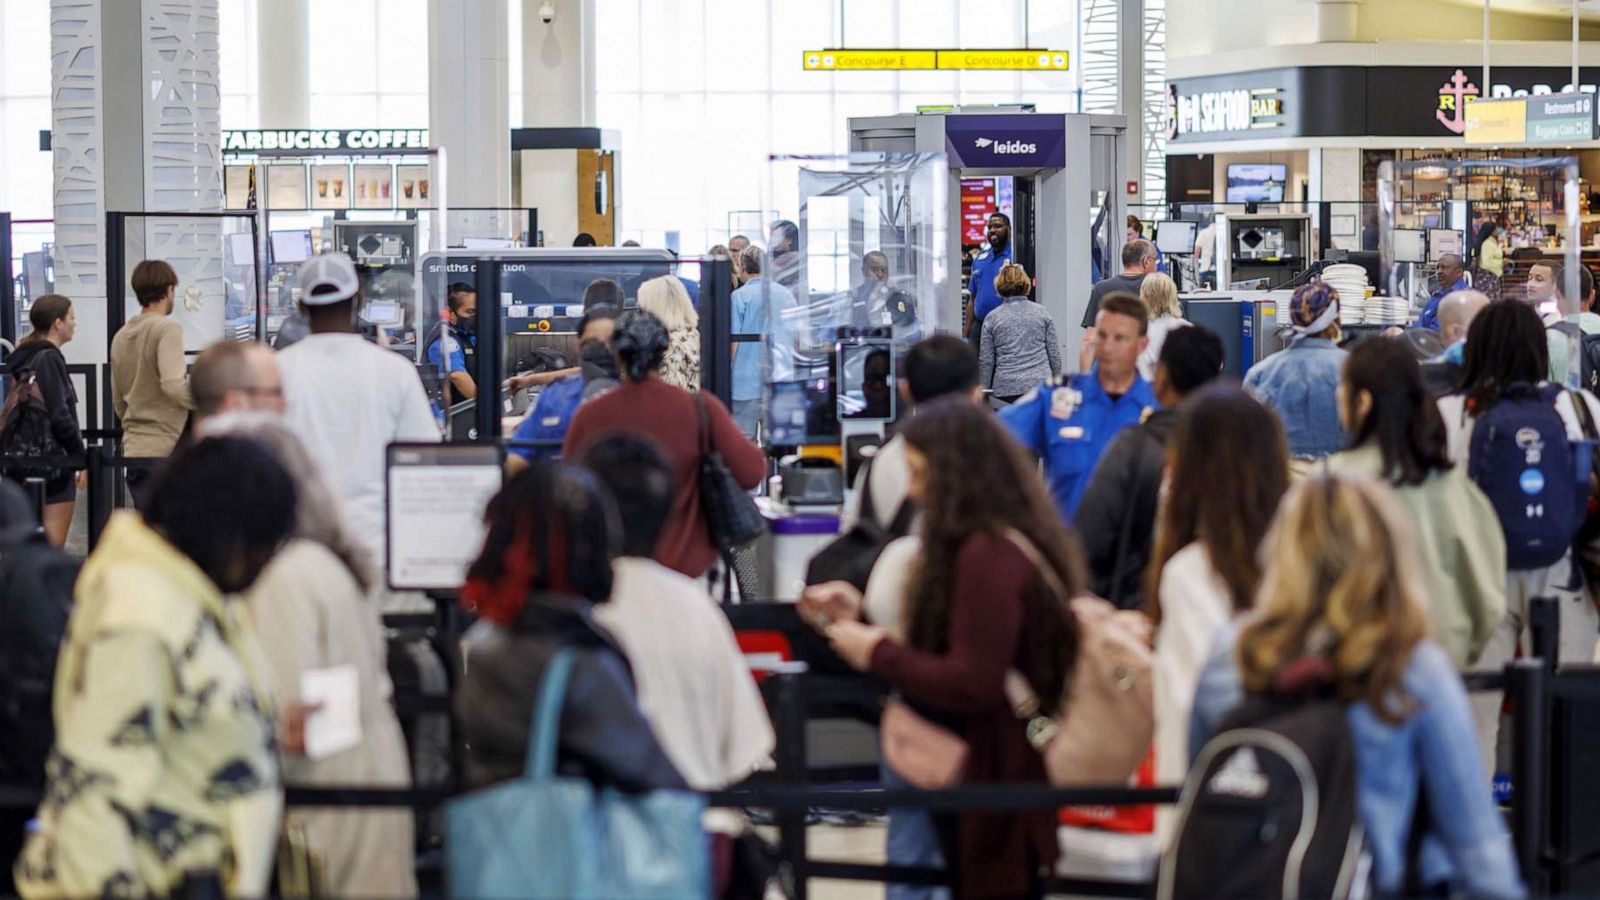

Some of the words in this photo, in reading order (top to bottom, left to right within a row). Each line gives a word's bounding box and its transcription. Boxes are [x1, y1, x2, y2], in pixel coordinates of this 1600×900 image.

[836, 56, 896, 66] Concourse
[899, 56, 906, 66] E
[964, 56, 1023, 66] Concourse
[1026, 56, 1036, 66] D
[1201, 89, 1250, 132] SEAFOOD
[1251, 98, 1279, 117] BAR
[1544, 101, 1576, 115] Restrooms
[221, 130, 341, 150] TARBUCKS
[993, 140, 1037, 154] leidos
